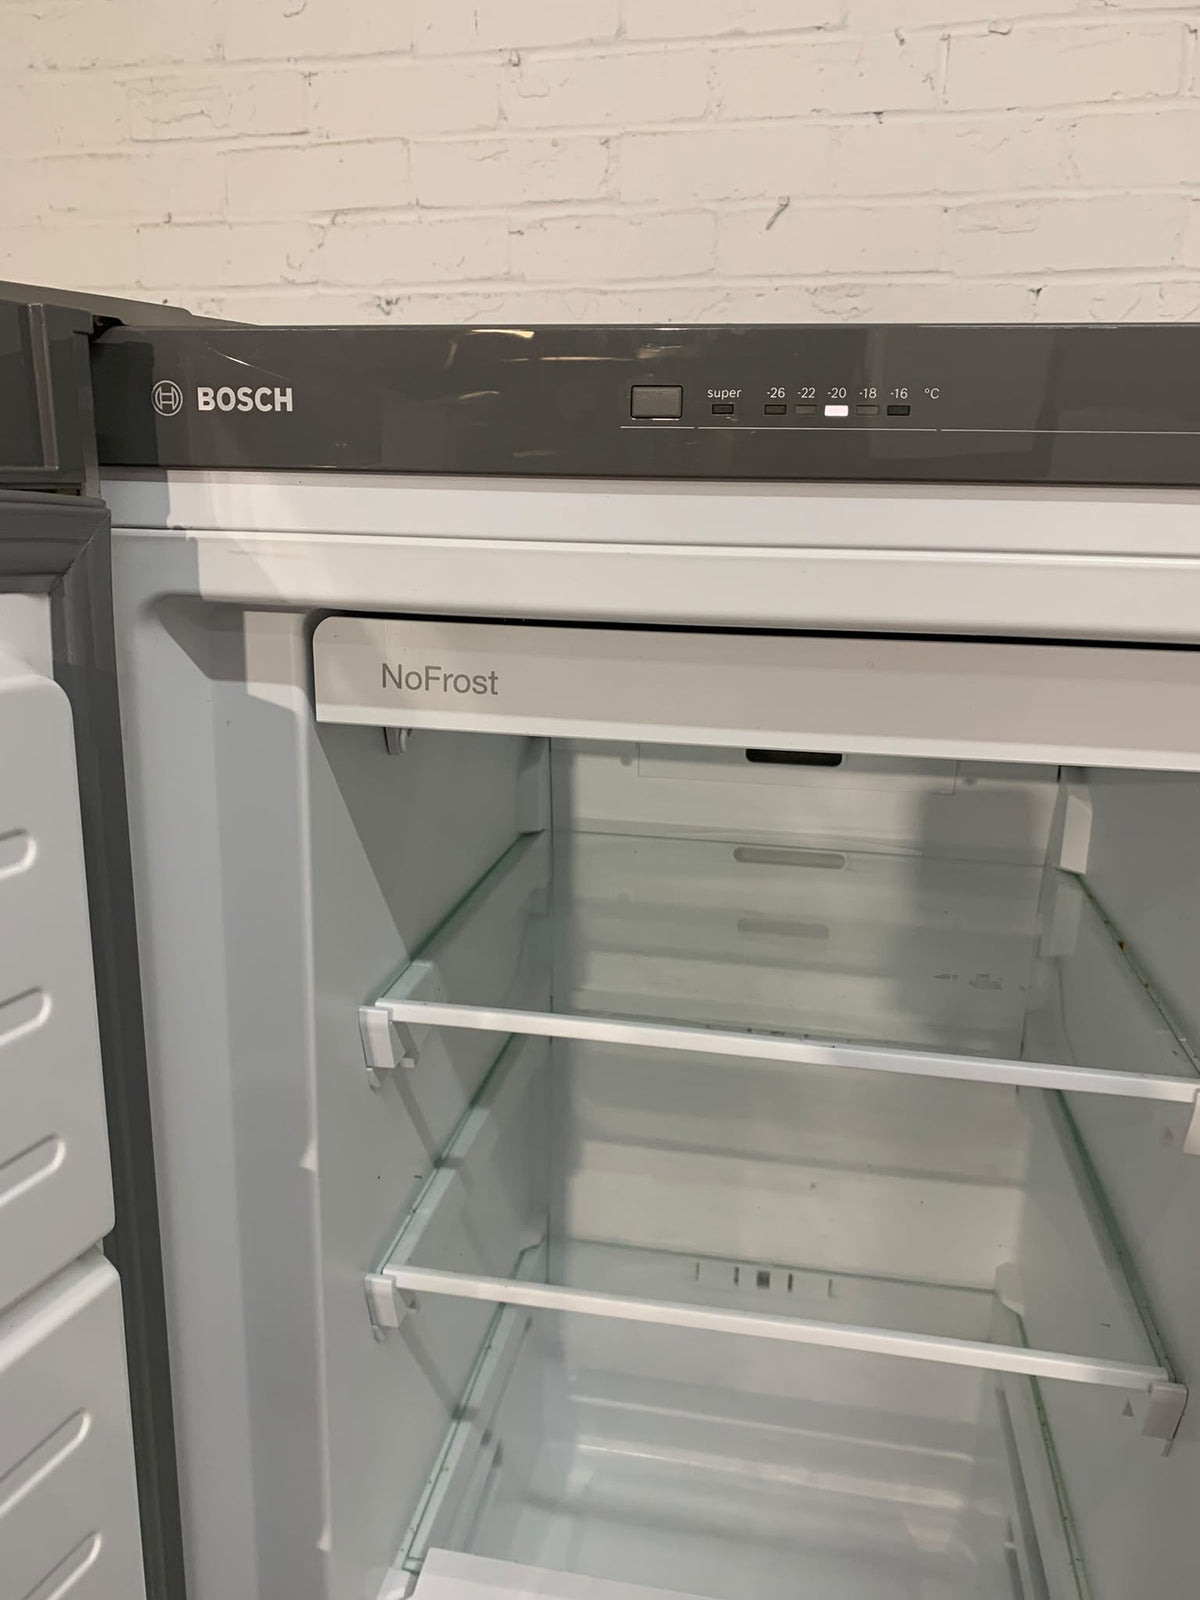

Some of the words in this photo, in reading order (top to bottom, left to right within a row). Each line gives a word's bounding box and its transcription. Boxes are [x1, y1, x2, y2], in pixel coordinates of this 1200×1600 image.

[197, 386, 293, 412] BOSCH
[707, 389, 742, 400] super
[766, 388, 786, 399] -26
[797, 388, 816, 399] -22
[827, 388, 847, 399] -20
[858, 388, 878, 399] -18
[890, 388, 909, 399] -16
[924, 387, 940, 399] °C
[381, 662, 499, 695] NoFrost
